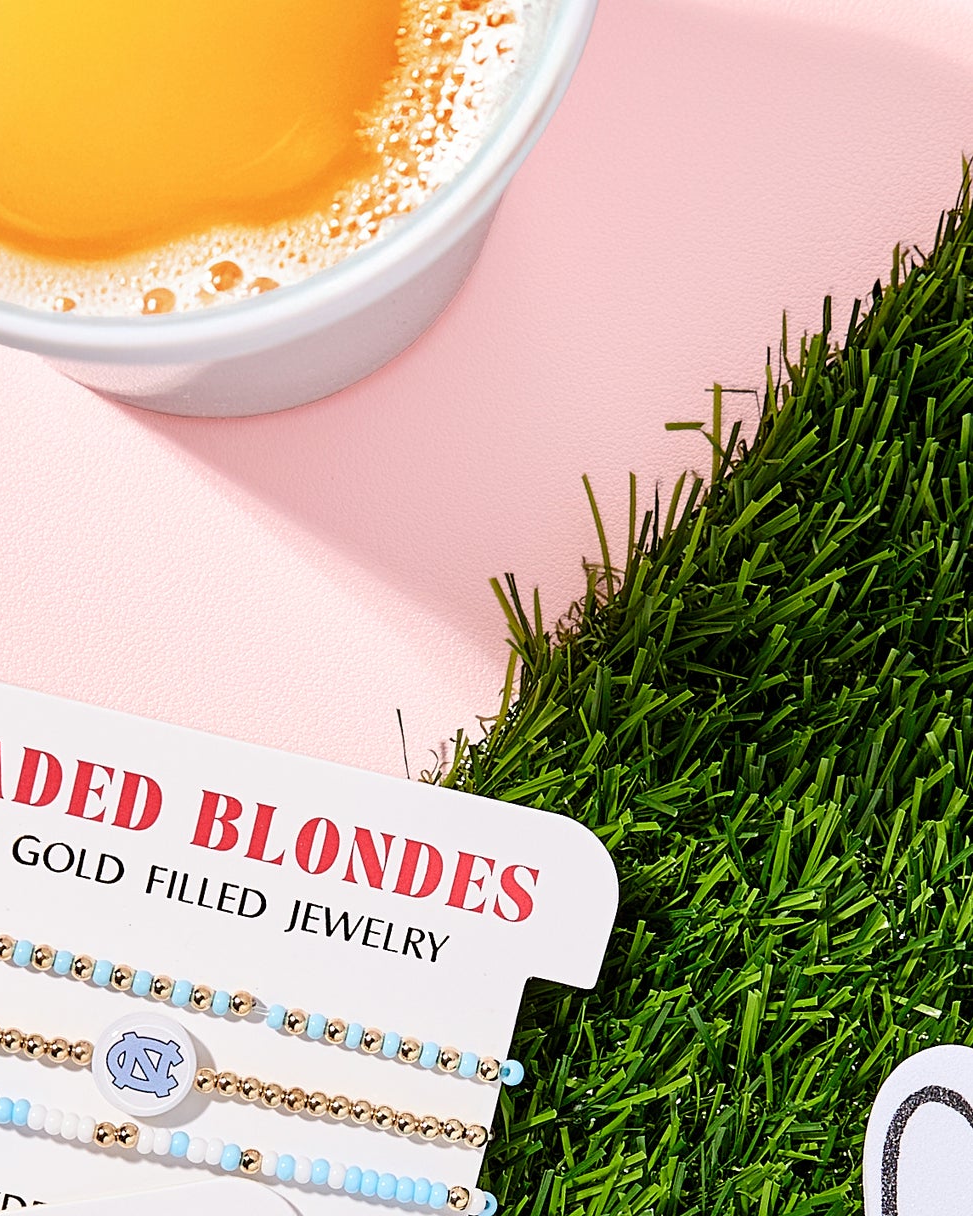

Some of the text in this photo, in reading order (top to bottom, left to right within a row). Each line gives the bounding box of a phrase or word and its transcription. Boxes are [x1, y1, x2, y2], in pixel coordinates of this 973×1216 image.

[12, 834, 125, 885] GOLD
[145, 864, 267, 919] FILLED
[284, 899, 450, 963] JEWELRY
[191, 789, 539, 924] BLONDES
